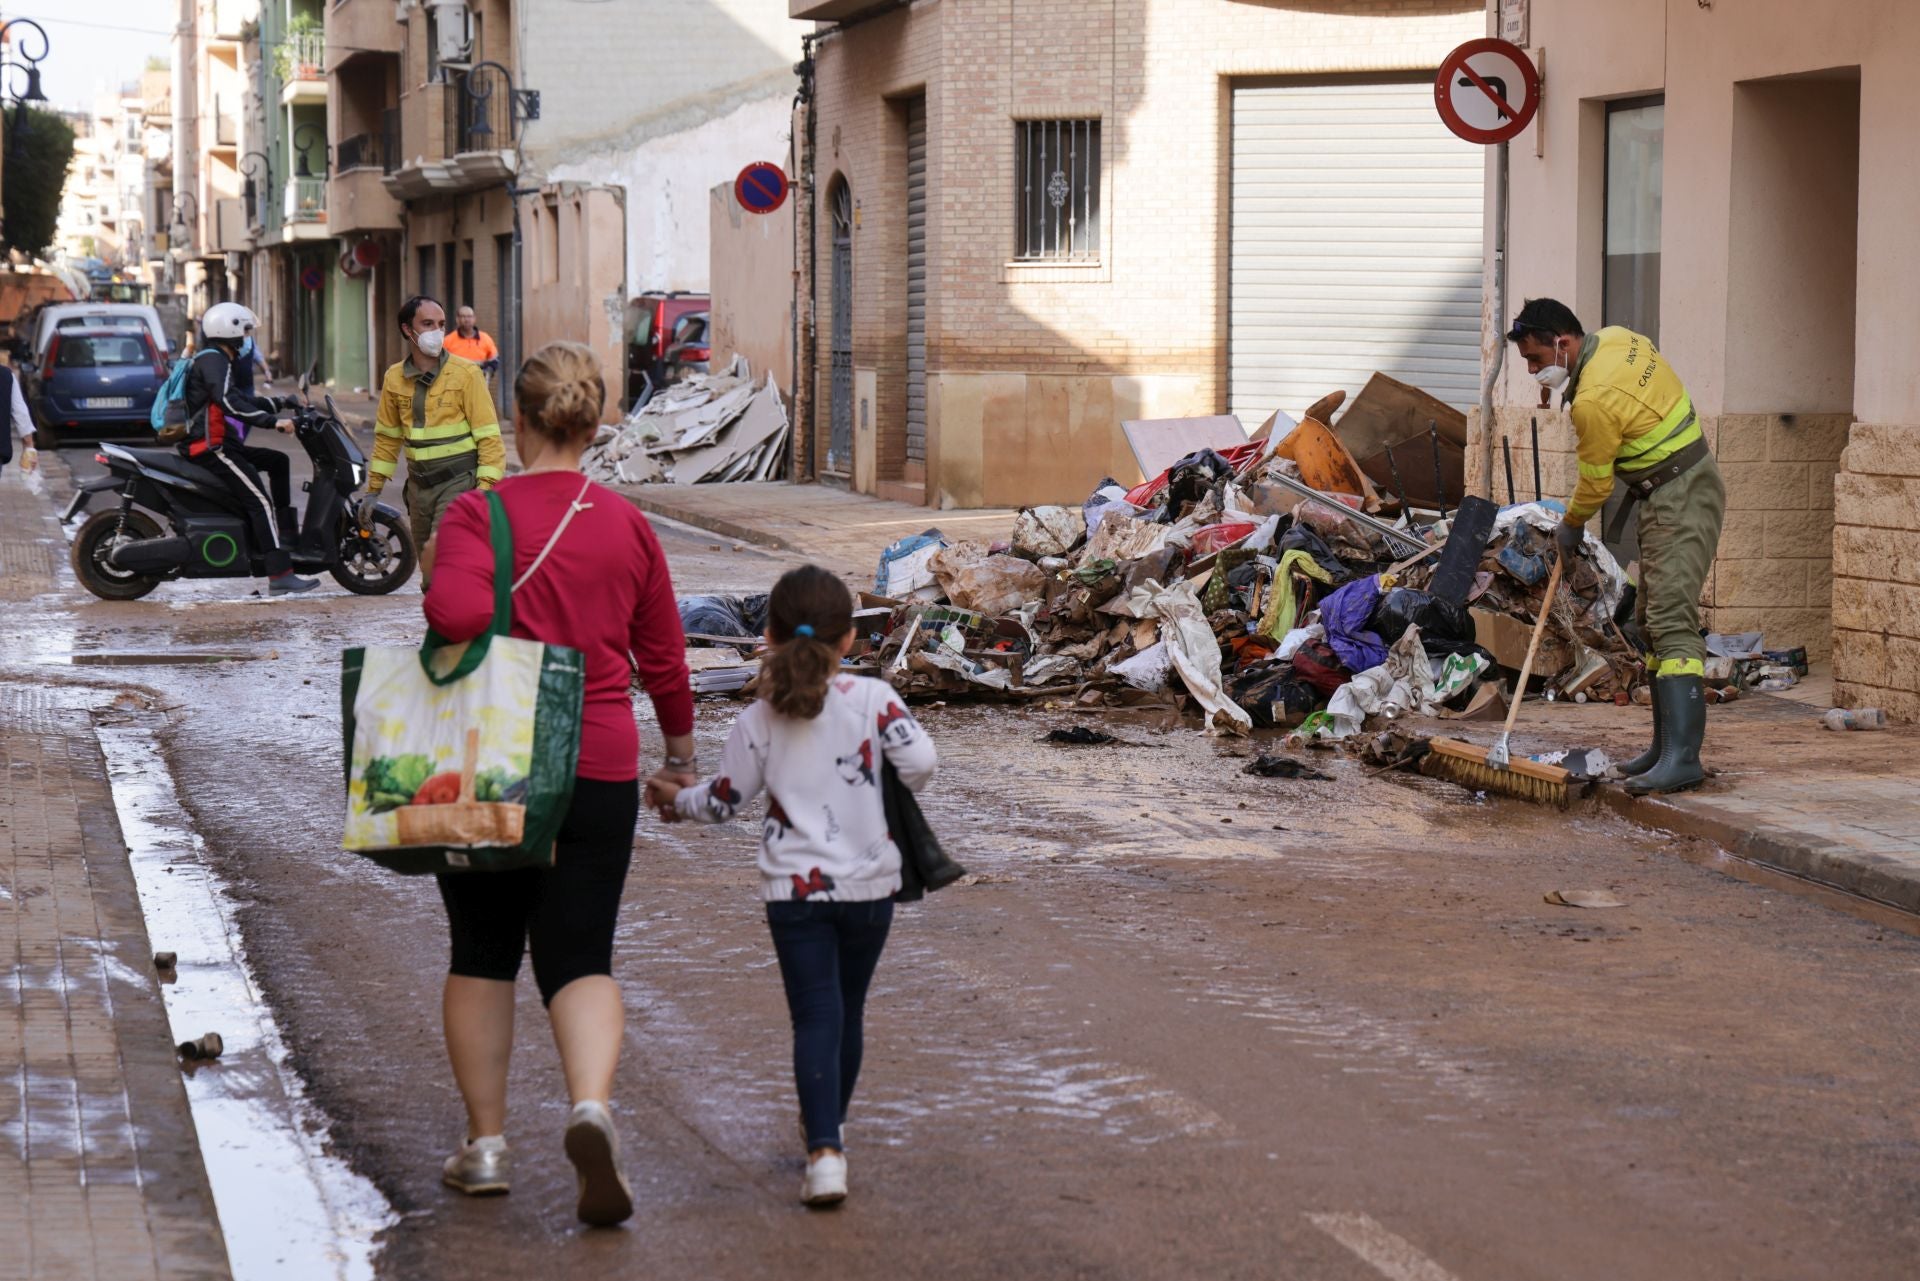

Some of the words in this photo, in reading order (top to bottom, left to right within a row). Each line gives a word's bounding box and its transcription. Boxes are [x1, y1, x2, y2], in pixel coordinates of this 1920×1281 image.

[1631, 336, 1638, 346] DE
[1626, 347, 1638, 366] JUNTA
[1638, 358, 1656, 387] CASTILLA
